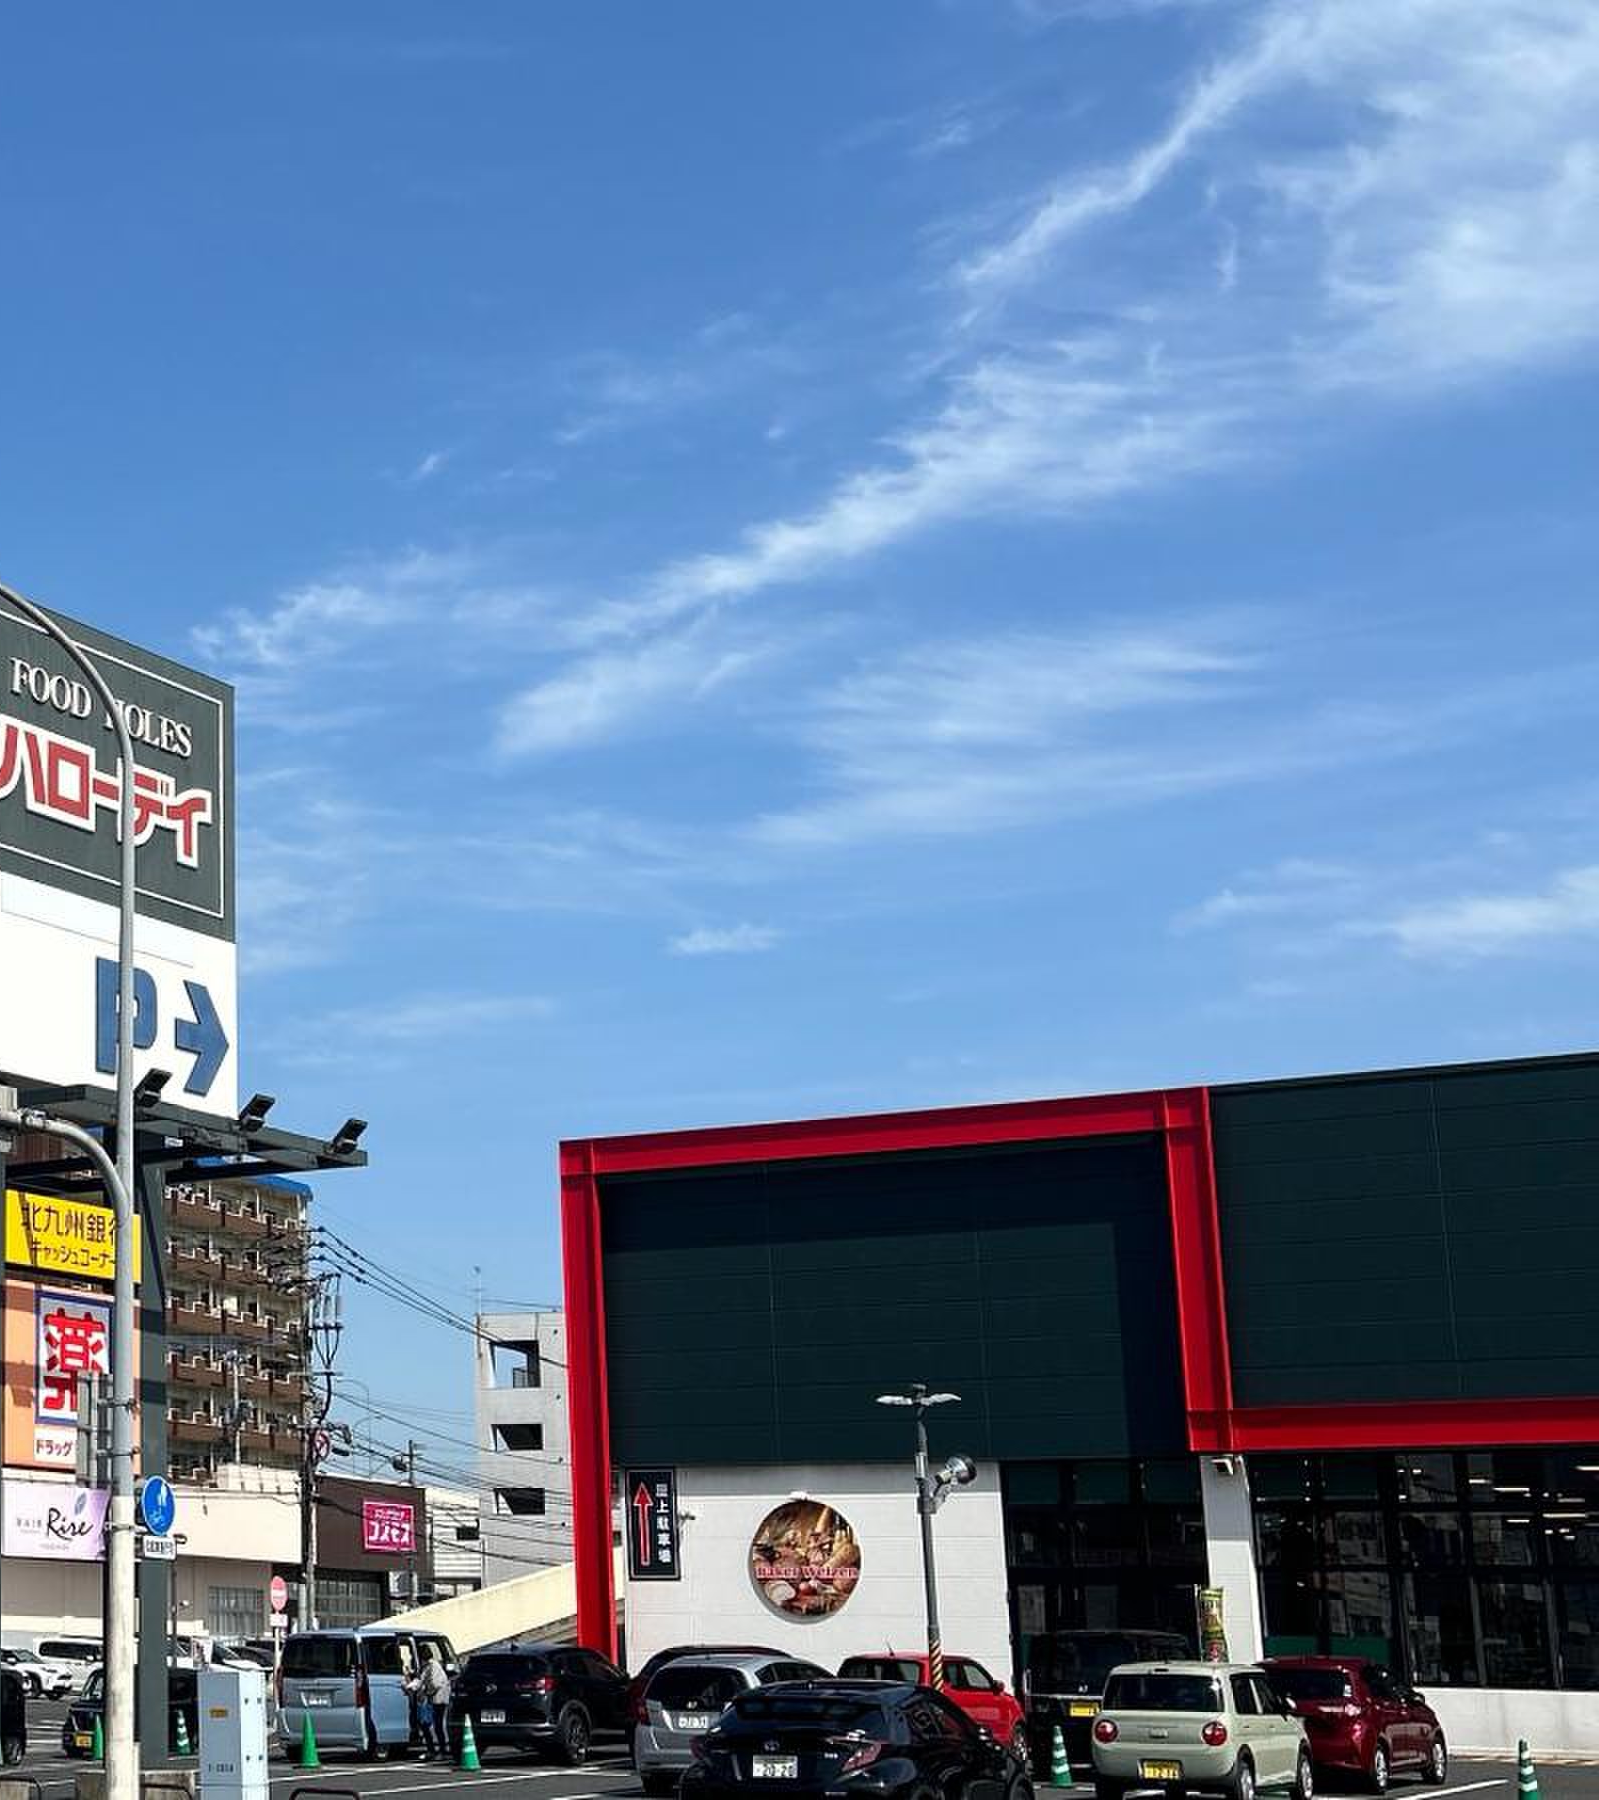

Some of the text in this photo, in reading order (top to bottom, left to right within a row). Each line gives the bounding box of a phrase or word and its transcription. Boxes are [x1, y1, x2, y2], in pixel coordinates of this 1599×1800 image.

[9, 656, 92, 718] FOOD
[96, 956, 158, 1075] P
[35, 1439, 74, 1457] ドラッグ
